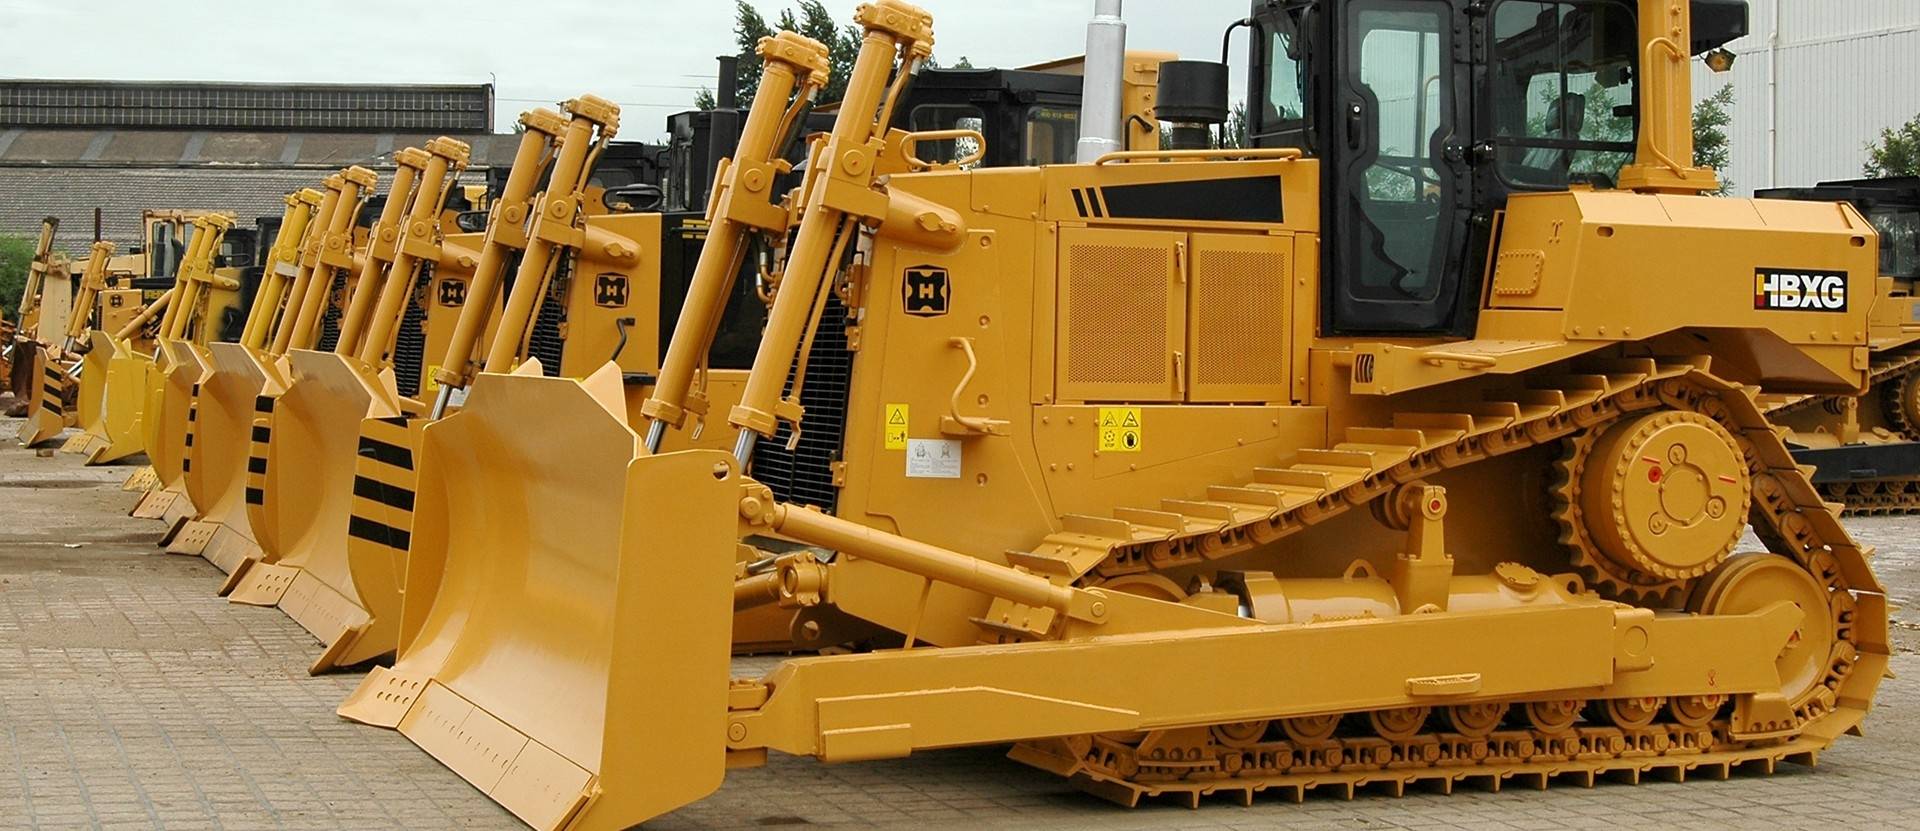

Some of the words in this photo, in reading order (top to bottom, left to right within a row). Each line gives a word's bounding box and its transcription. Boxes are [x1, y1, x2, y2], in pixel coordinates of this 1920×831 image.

[606, 285, 617, 296] H
[919, 283, 934, 299] H
[1756, 273, 1844, 309] HBXG
